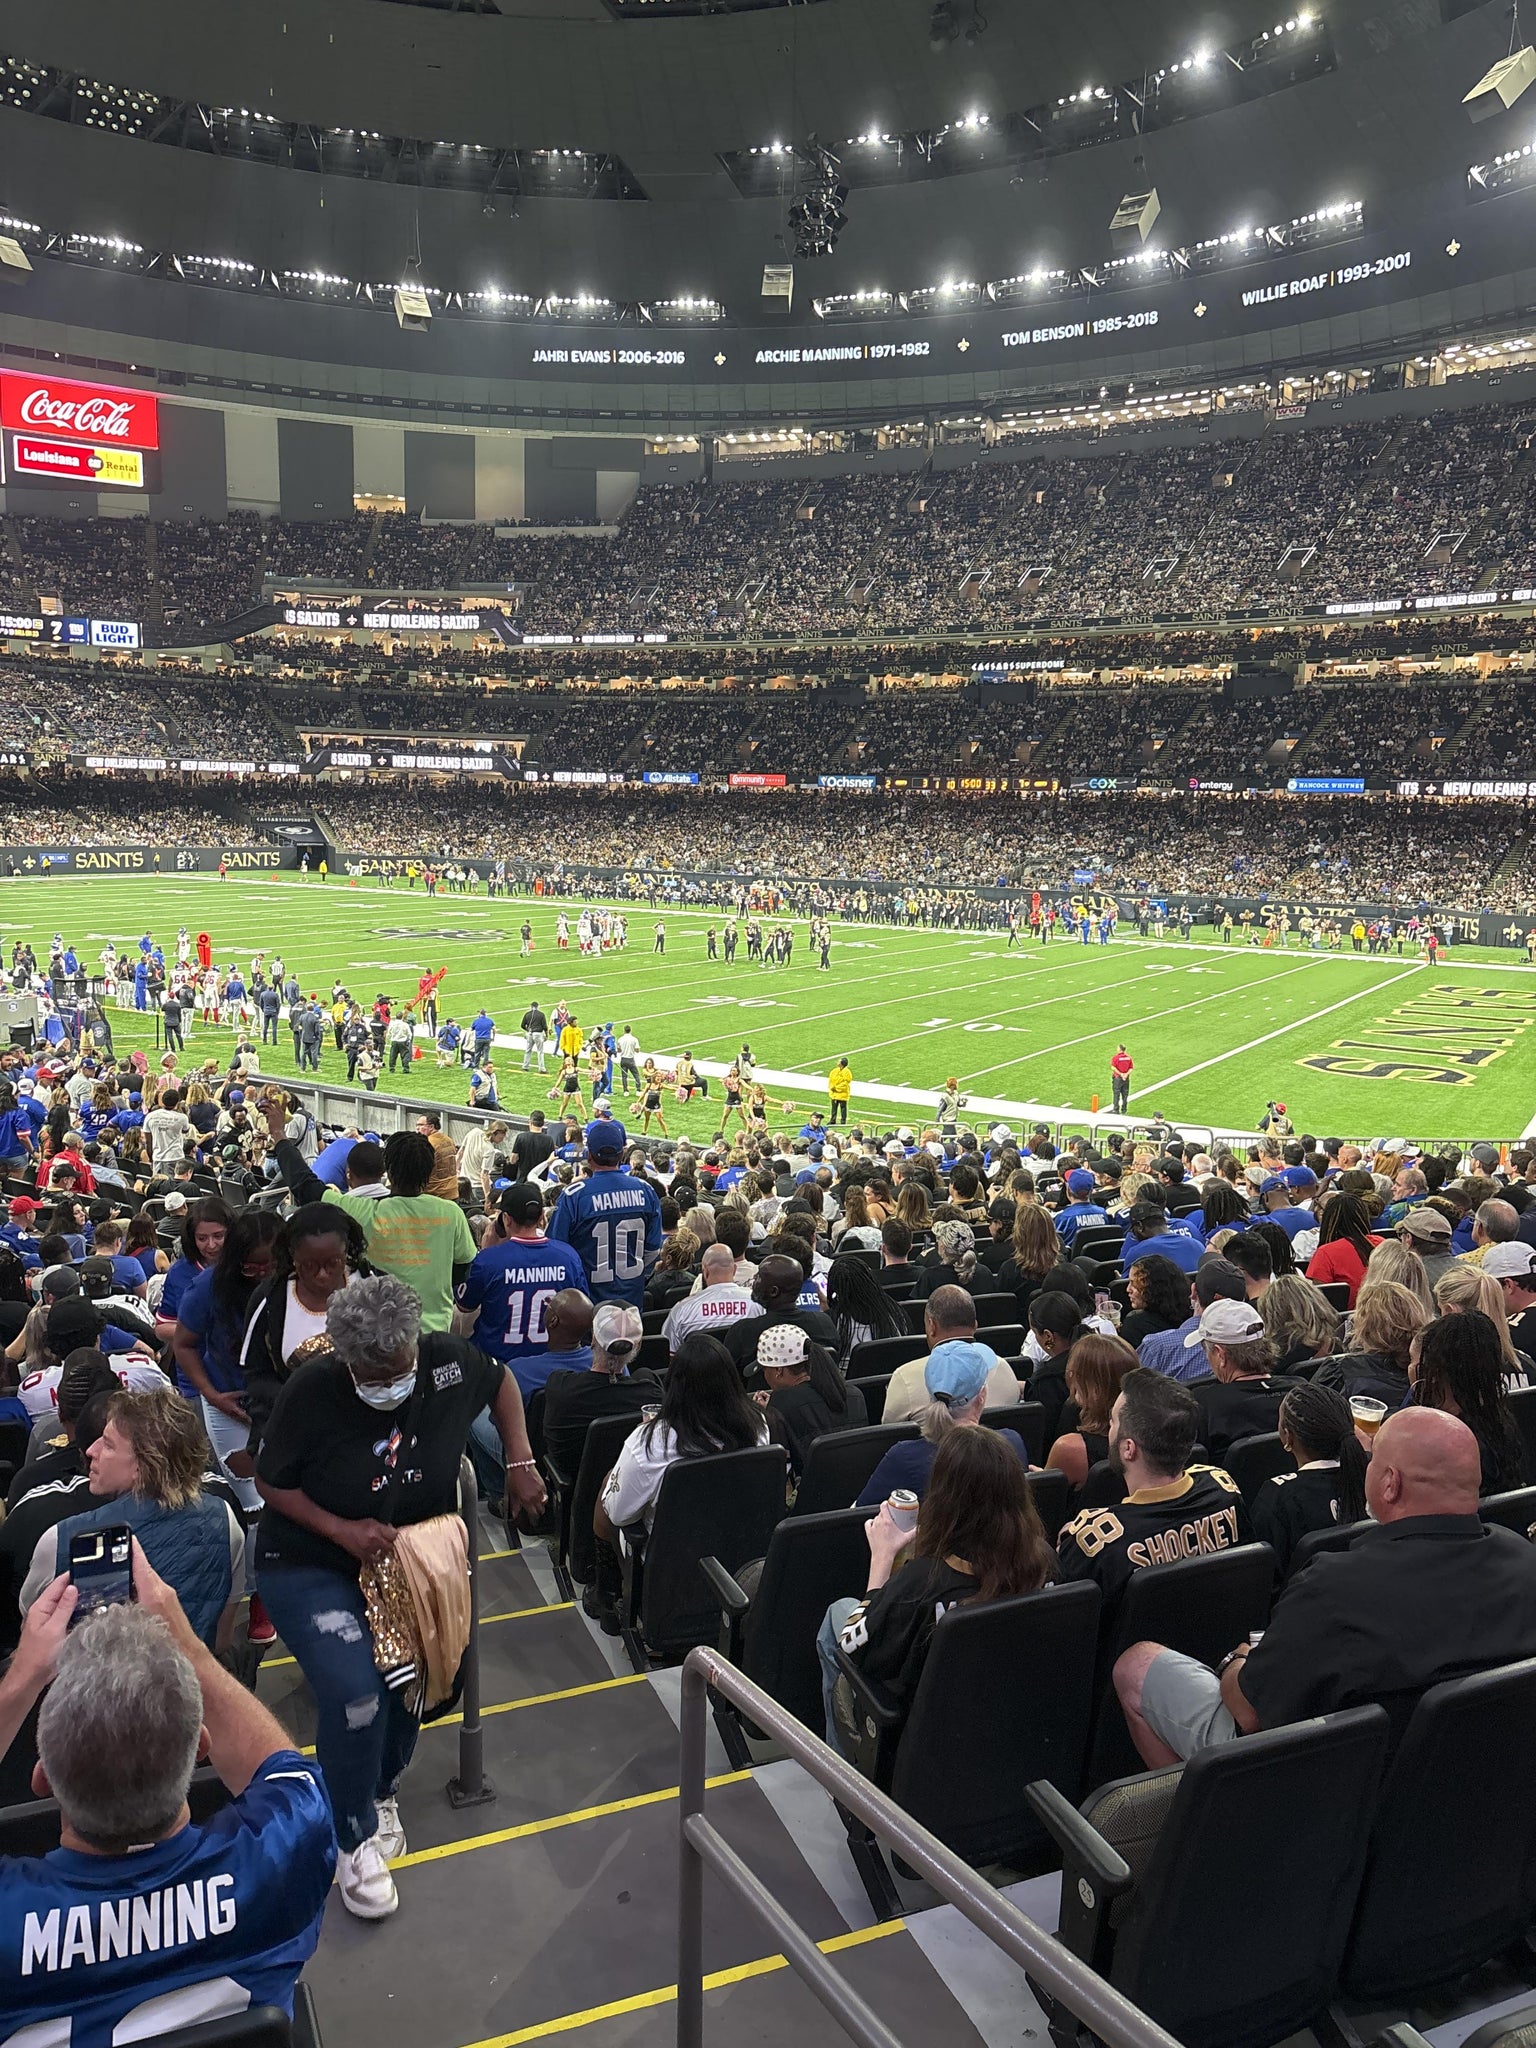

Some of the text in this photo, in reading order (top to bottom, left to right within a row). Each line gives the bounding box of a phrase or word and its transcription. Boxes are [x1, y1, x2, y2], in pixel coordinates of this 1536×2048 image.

[1241, 251, 1412, 308] WILLIE ROAF 1993-2001
[1001, 310, 1159, 347] TOM BENSON 1985-2018
[532, 349, 686, 365] JAHRI EVANS 2006-2016
[755, 341, 931, 364] ARCHIE MANNING 1971-1982
[20, 389, 136, 437] Coca-Cola
[1277, 405, 1304, 416] WWL
[23, 447, 81, 468] Louisiana
[105, 460, 139, 474] Rental
[50, 620, 63, 635] 7
[297, 611, 480, 630] SAINTS NEW ORLEANS SAINTS
[677, 633, 705, 642] SAINTS
[736, 632, 764, 640] SAINTS
[794, 630, 823, 639] SAINTS
[856, 629, 885, 637] SAINTS
[918, 626, 948, 634] SAINTS
[983, 623, 1014, 632] SAINTS
[1050, 619, 1083, 628] SAINTS
[1120, 615, 1154, 625] SAINTS
[1192, 612, 1227, 621] SAINTS
[1268, 607, 1304, 617] SAINTS
[101, 624, 130, 635] BUD
[96, 633, 135, 644] LIGHT
[297, 658, 325, 667] SAINTS
[358, 661, 386, 670] SAINTS
[418, 664, 446, 673] SAINTS
[479, 666, 506, 674] SAINTS
[540, 668, 566, 676] SAINTS
[595, 668, 621, 676] SAINTS
[653, 668, 679, 676] SAINTS
[709, 668, 735, 676] SAINTS
[767, 667, 794, 675] SAINTS
[825, 666, 852, 674] SAINTS
[883, 665, 911, 673] SAINTS
[943, 663, 972, 671] SAINTS
[1066, 658, 1096, 667] SAINTS
[1132, 656, 1163, 665] SAINTS
[1202, 653, 1234, 663] SAINTS
[1273, 650, 1307, 659] SAINTS
[1351, 647, 1387, 657] SAINTS
[1431, 643, 1469, 653] SAINTS
[971, 659, 1065, 672] CAESARS SUPERDOME
[33, 752, 68, 762] SAINTS
[85, 756, 103, 768] NEW
[103, 757, 138, 770] ORLEANS
[138, 759, 167, 770] SAINTS
[180, 760, 198, 771] NEW
[198, 761, 230, 772] ORLEANS
[230, 762, 256, 773] SAINTS
[268, 763, 284, 773] NEW
[338, 753, 372, 767] SAINTS
[392, 754, 416, 768] NEW
[417, 755, 461, 769] ORLEANS
[461, 756, 493, 770] SAINTS
[553, 771, 572, 782] NEW
[572, 771, 607, 783] ORLEANS
[701, 774, 728, 782] SAINTS
[732, 774, 766, 785] Community
[829, 776, 874, 788] Ochsner
[1089, 778, 1118, 789] COX
[1140, 778, 1173, 788] SAINTS
[1199, 779, 1234, 792] entergy
[1298, 781, 1364, 791] HANCOCK WHITNEY
[1443, 782, 1470, 796] NEW
[1471, 782, 1526, 796] ORLEANS
[75, 851, 144, 869] SAINTS
[221, 851, 281, 867] SAINTS
[359, 858, 424, 874] SAINTS
[911, 1017, 1005, 1033] 10
[1294, 984, 1536, 1086] SAINTS
[592, 1189, 646, 1212] MANNING
[1075, 1214, 1106, 1227] MANNING
[591, 1217, 647, 1284] 10
[505, 1266, 567, 1285] MANNING
[702, 1300, 747, 1317] BARBER
[432, 1360, 460, 1377] CRUCIAL
[434, 1367, 462, 1385] CATCH
[371, 1468, 423, 1492] SATS
[1127, 1505, 1239, 1568] SHOCKEY
[21, 1873, 237, 1976] MANNING
